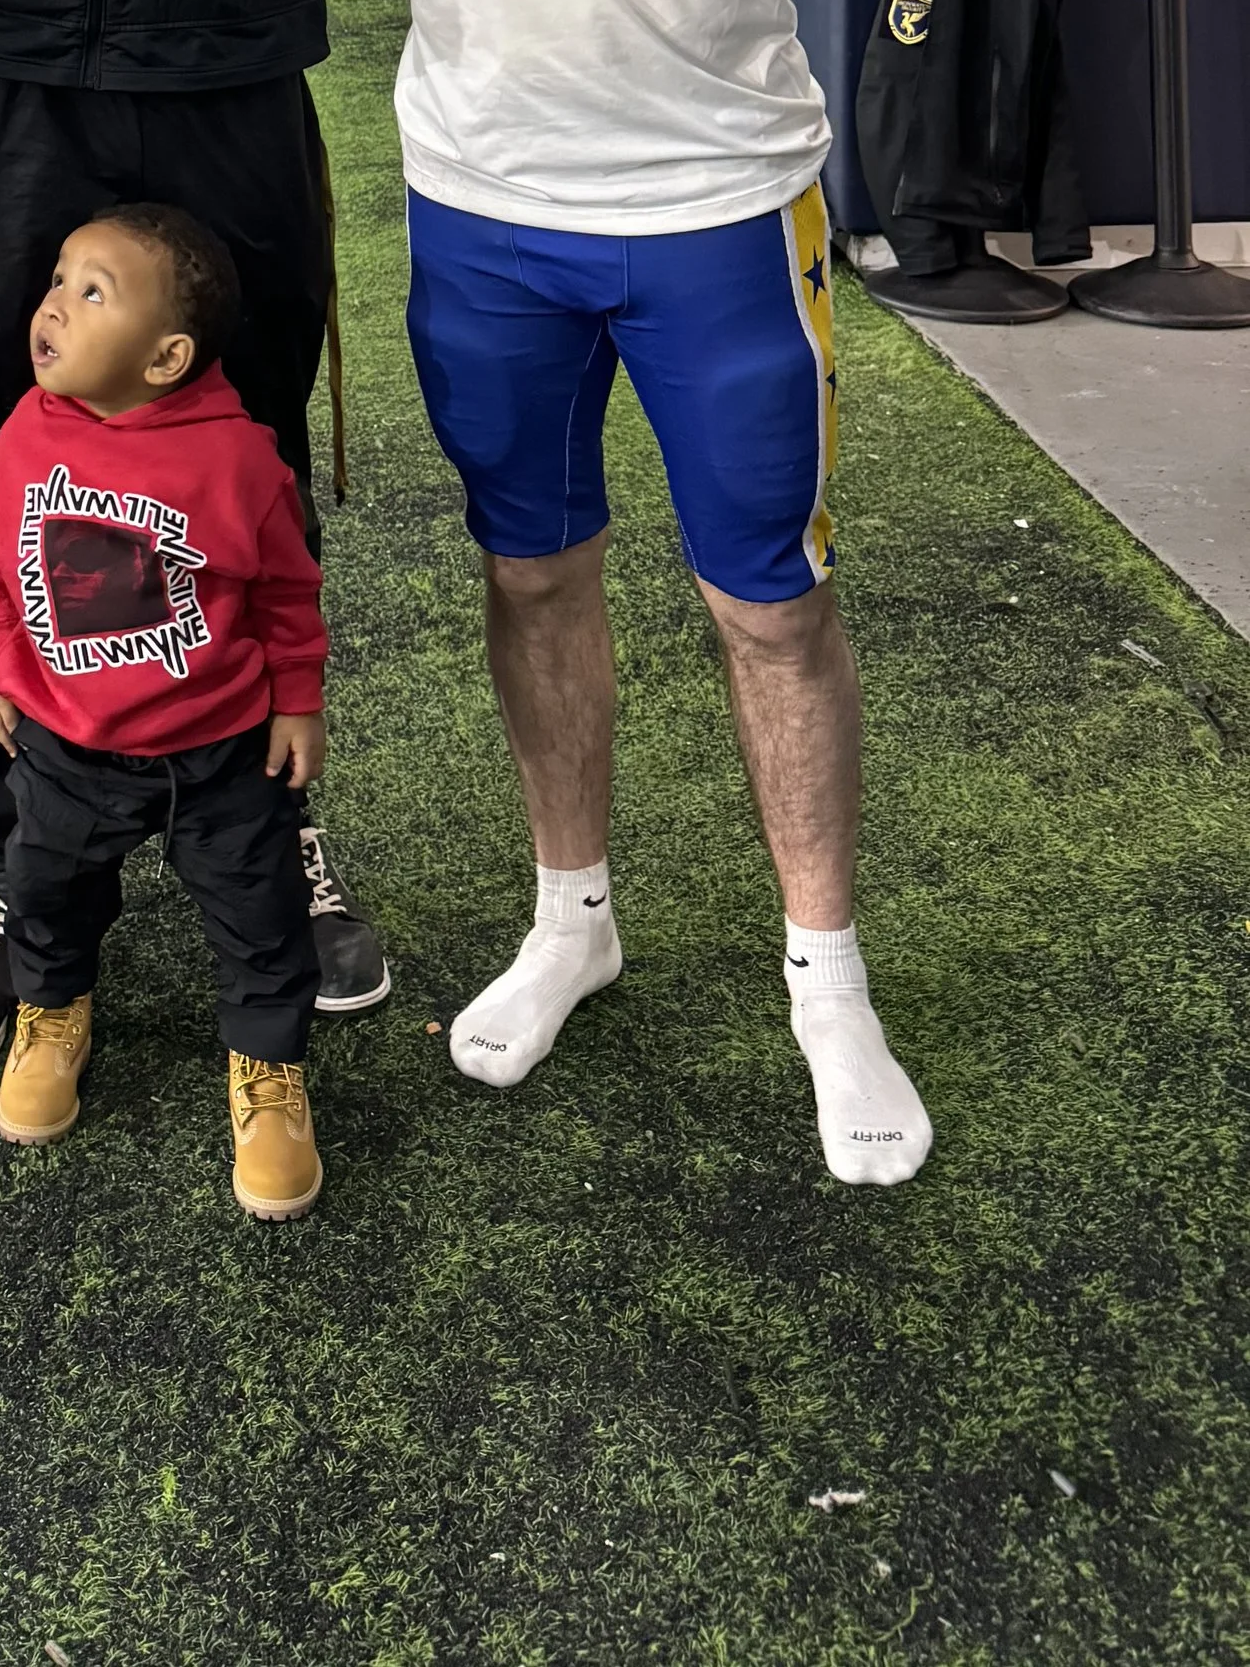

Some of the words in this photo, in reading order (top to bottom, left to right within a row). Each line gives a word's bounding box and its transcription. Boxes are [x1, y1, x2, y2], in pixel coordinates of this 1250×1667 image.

[26, 467, 120, 518] WAYNE
[125, 495, 162, 530] LIL
[20, 514, 42, 554] LIL
[159, 509, 205, 584] YNE
[169, 576, 200, 620] LIL
[56, 642, 99, 672] LIL
[94, 615, 208, 676] WAYNE
[849, 1130, 904, 1143] DRI-FIT
